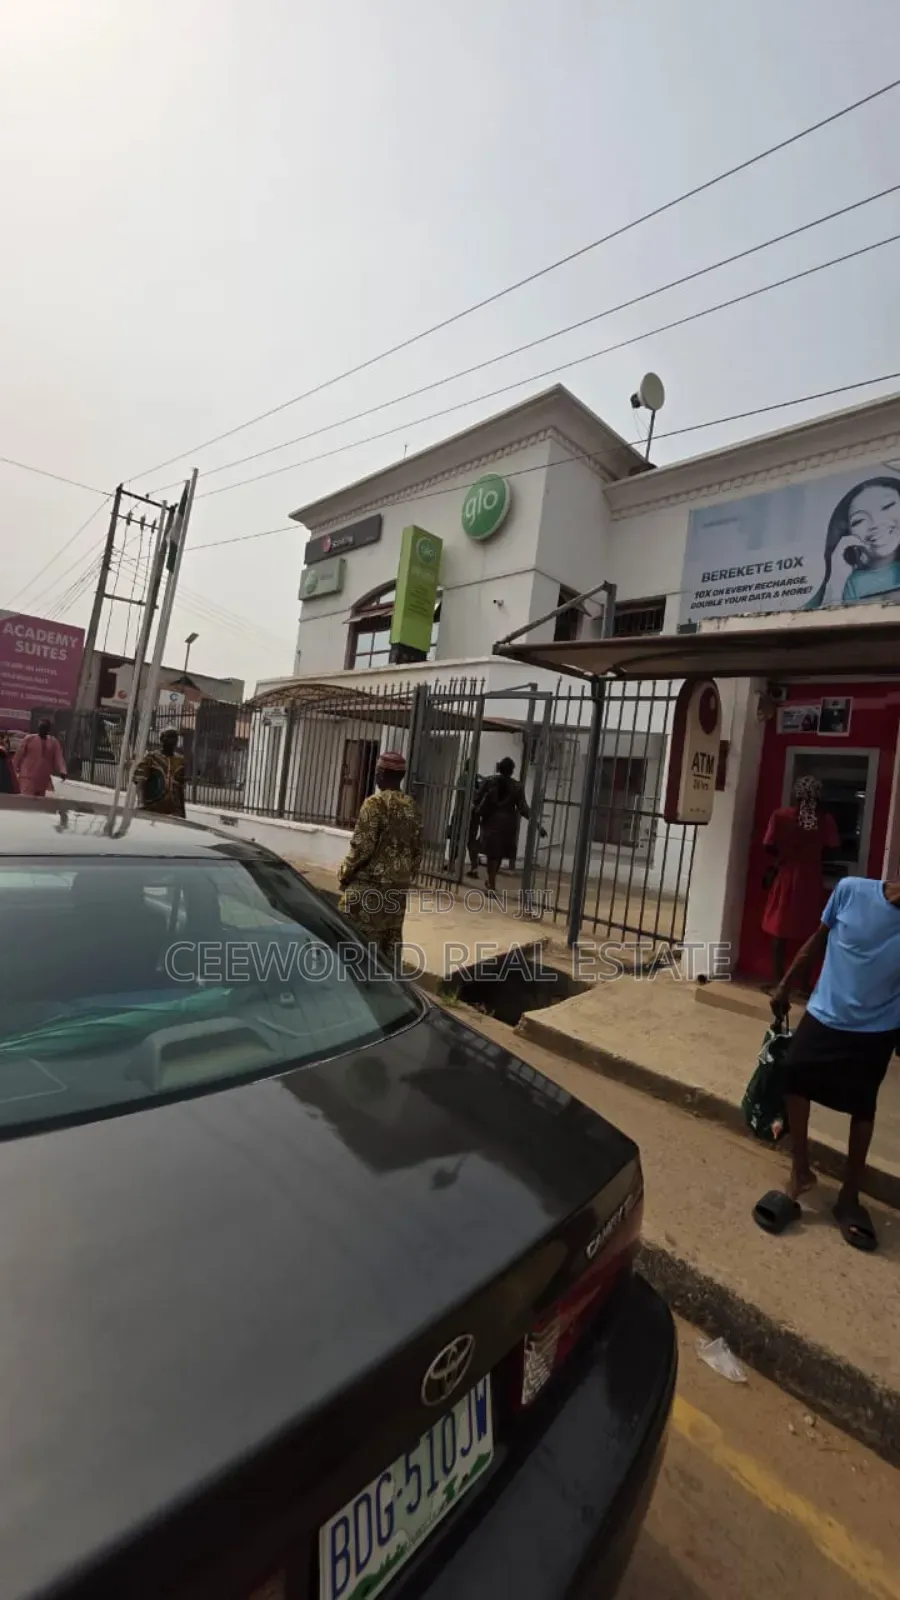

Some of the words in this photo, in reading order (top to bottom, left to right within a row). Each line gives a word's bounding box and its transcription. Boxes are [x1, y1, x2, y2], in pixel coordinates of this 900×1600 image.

[465, 487, 498, 528] glo
[701, 561, 774, 583] BEREKETE
[776, 556, 804, 572] 10X
[690, 598, 723, 610] DOUBLE
[724, 594, 748, 605] YOUR
[748, 590, 772, 602] DATA
[773, 591, 781, 599] &
[694, 590, 711, 600] 10X
[712, 588, 725, 597] ON
[725, 583, 754, 594] EVERY
[3, 622, 79, 649] ACADEMY
[15, 640, 68, 661] SUITES
[691, 752, 715, 775] ATM
